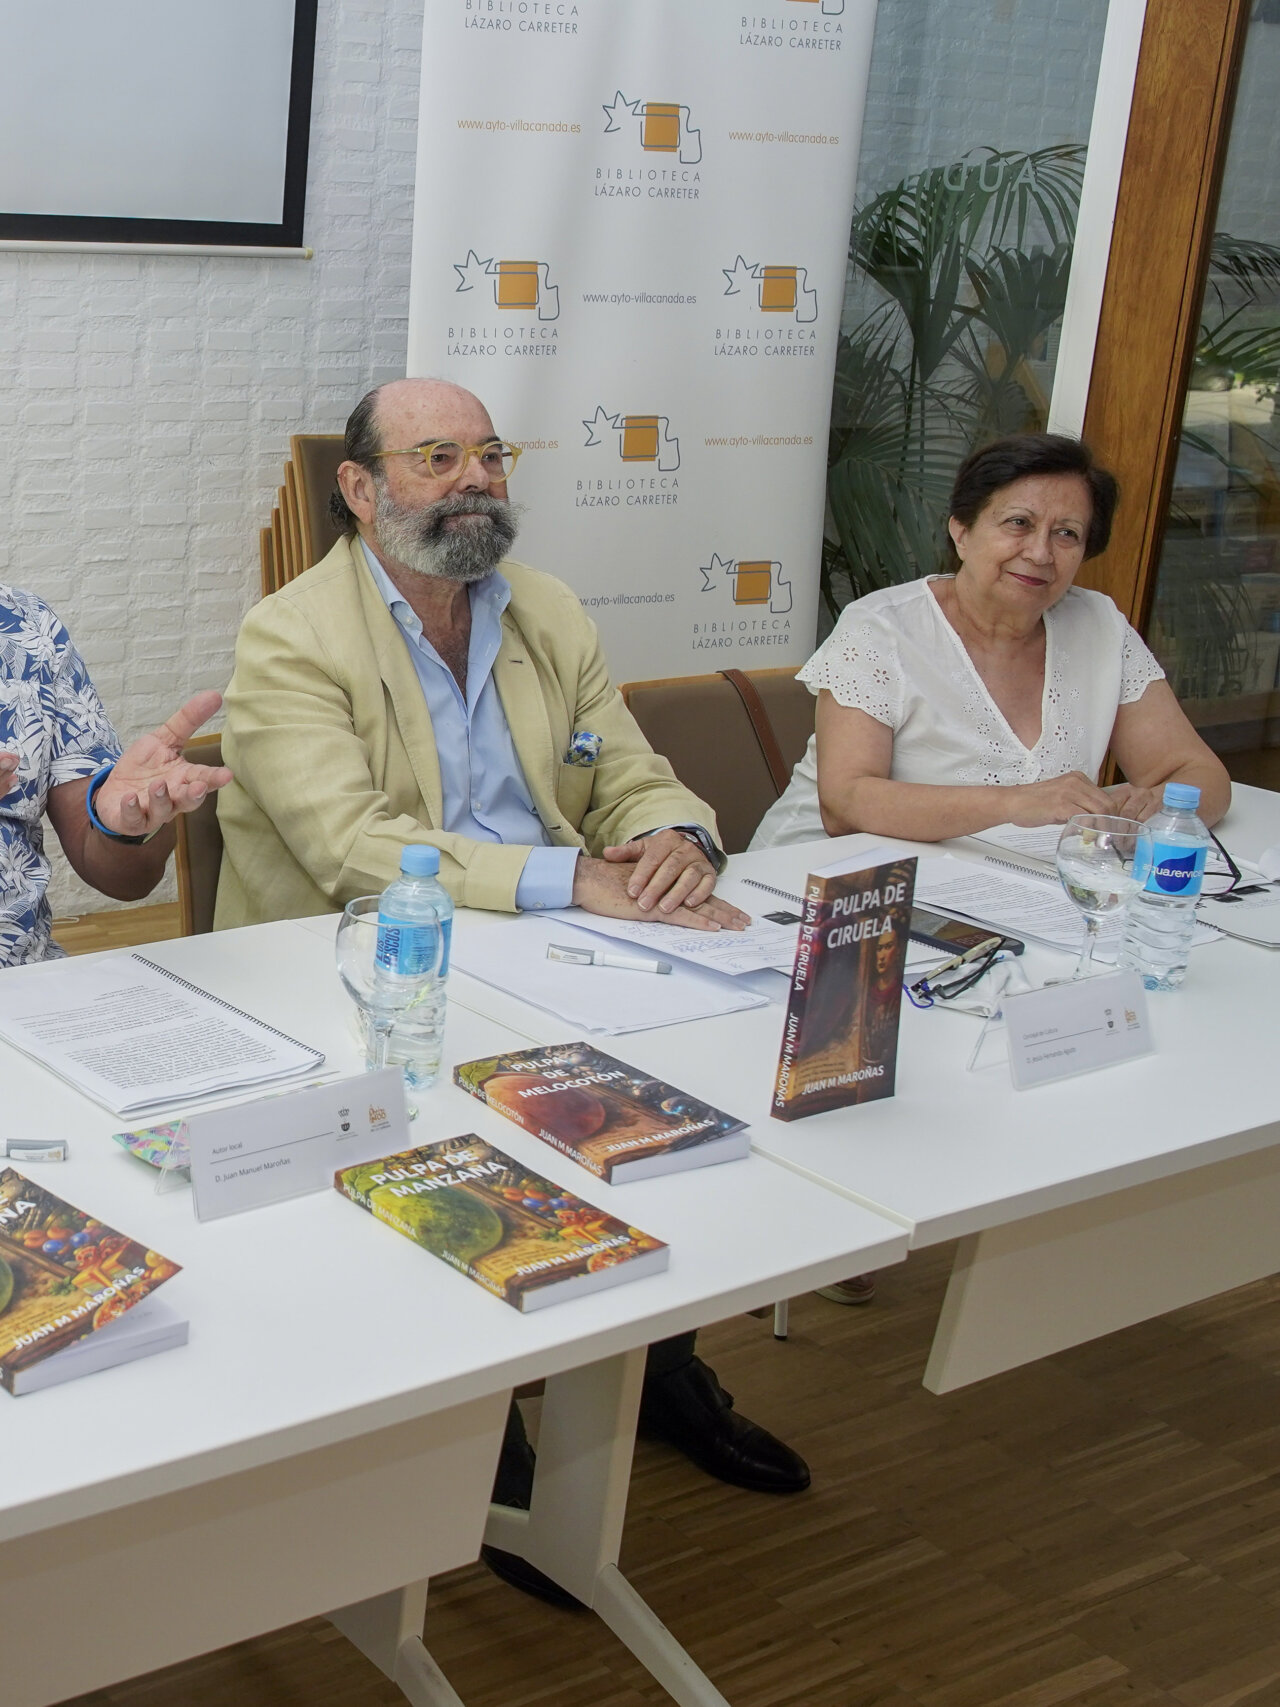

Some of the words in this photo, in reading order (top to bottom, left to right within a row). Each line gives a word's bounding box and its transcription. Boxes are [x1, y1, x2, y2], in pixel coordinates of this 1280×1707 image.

[465, 0, 579, 16] BIBLIOTECA
[465, 15, 512, 31] LÁZARO
[519, 21, 578, 34] CARRETER
[741, 16, 843, 34] BIBLIOTECA
[740, 32, 783, 48] LÁZARO
[789, 37, 842, 51] CARRETER
[457, 119, 581, 134] www.ayto-villacanada.es
[729, 130, 840, 145] www.ayto-villacanada.es
[595, 168, 701, 182] BIBLIOTECA
[594, 183, 641, 198] LÁZARO
[648, 186, 700, 199] CARRETER
[582, 292, 697, 305] www.ayto-villacanada.es
[448, 327, 559, 339] BIBLIOTECA
[715, 329, 817, 340] BIBLIOTECA
[447, 342, 497, 356] LÁZARO
[504, 344, 558, 356] CARRETER
[714, 343, 758, 356] LÁZARO
[764, 345, 816, 356] CARRETER
[704, 433, 814, 448] www.ayto-villacanada.es
[576, 478, 680, 491] BIBLIOTECA
[575, 494, 620, 507] LÁZARO
[626, 494, 679, 506] CARRETER
[579, 592, 676, 608] w.ayto-villacanada.es
[693, 619, 791, 634] BIBLIOTECA
[692, 637, 733, 650] LÁZARO
[738, 634, 790, 647] CARRETER
[804, 886, 821, 923] PULPA
[831, 889, 880, 920] PULPA
[883, 882, 907, 906] DE
[801, 925, 816, 943] DE
[826, 915, 893, 949] CIRUELA
[794, 942, 812, 991] CIRUELA
[785, 1012, 800, 1042] JUAN
[783, 1042, 795, 1054] M
[510, 1055, 568, 1072] PULPA
[541, 1069, 570, 1080] DE
[774, 1054, 793, 1108] MAROÑAS
[801, 1080, 828, 1096] JUAN
[827, 1077, 837, 1089] M
[837, 1065, 885, 1086] MAROÑAS
[517, 1070, 626, 1099] MELOCOTÓN
[459, 1076, 479, 1096] PULPA
[477, 1087, 487, 1101] DE
[487, 1094, 524, 1125] MELOCOTÓN
[605, 1139, 639, 1153] JUAN
[637, 1136, 654, 1145] M
[652, 1118, 716, 1142] MAROÑAS
[539, 1128, 559, 1146] JUAN
[558, 1139, 567, 1152] M
[564, 1147, 604, 1175] MAROÑAS
[370, 1160, 447, 1186] PULPA
[443, 1149, 480, 1167] DE
[390, 1160, 509, 1198] MANZANA
[342, 1183, 367, 1206] PULPA
[366, 1196, 378, 1213] DE
[379, 1206, 417, 1236] MANZANA
[440, 1251, 461, 1267] JUAN
[460, 1260, 471, 1273] M
[515, 1261, 551, 1276] JUAN
[550, 1254, 566, 1265] M
[563, 1234, 631, 1260] MAROÑAS
[13, 1323, 56, 1350] JUAN
[54, 1315, 72, 1328] M
[71, 1266, 146, 1318] MAROÑAS
